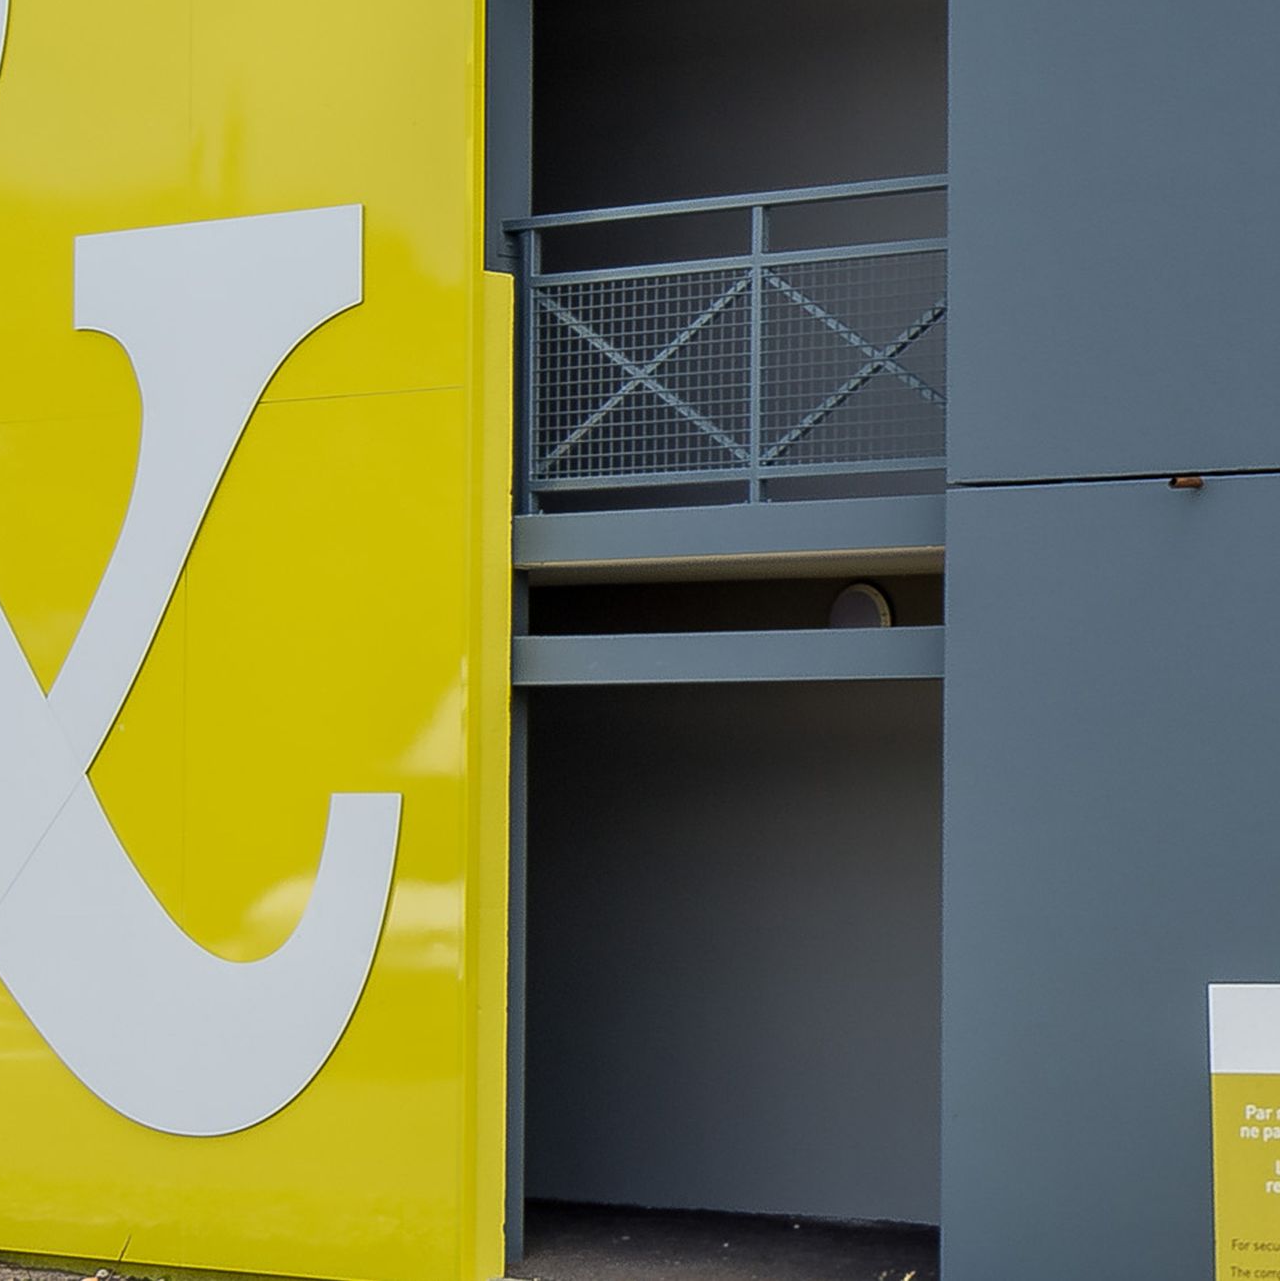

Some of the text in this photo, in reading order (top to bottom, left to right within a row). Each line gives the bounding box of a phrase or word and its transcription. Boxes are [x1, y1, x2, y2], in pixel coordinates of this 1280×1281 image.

[1244, 1104, 1272, 1120] Par
[1239, 1125, 1260, 1139] ne
[1231, 1238, 1249, 1251] For
[1230, 1265, 1251, 1279] The
